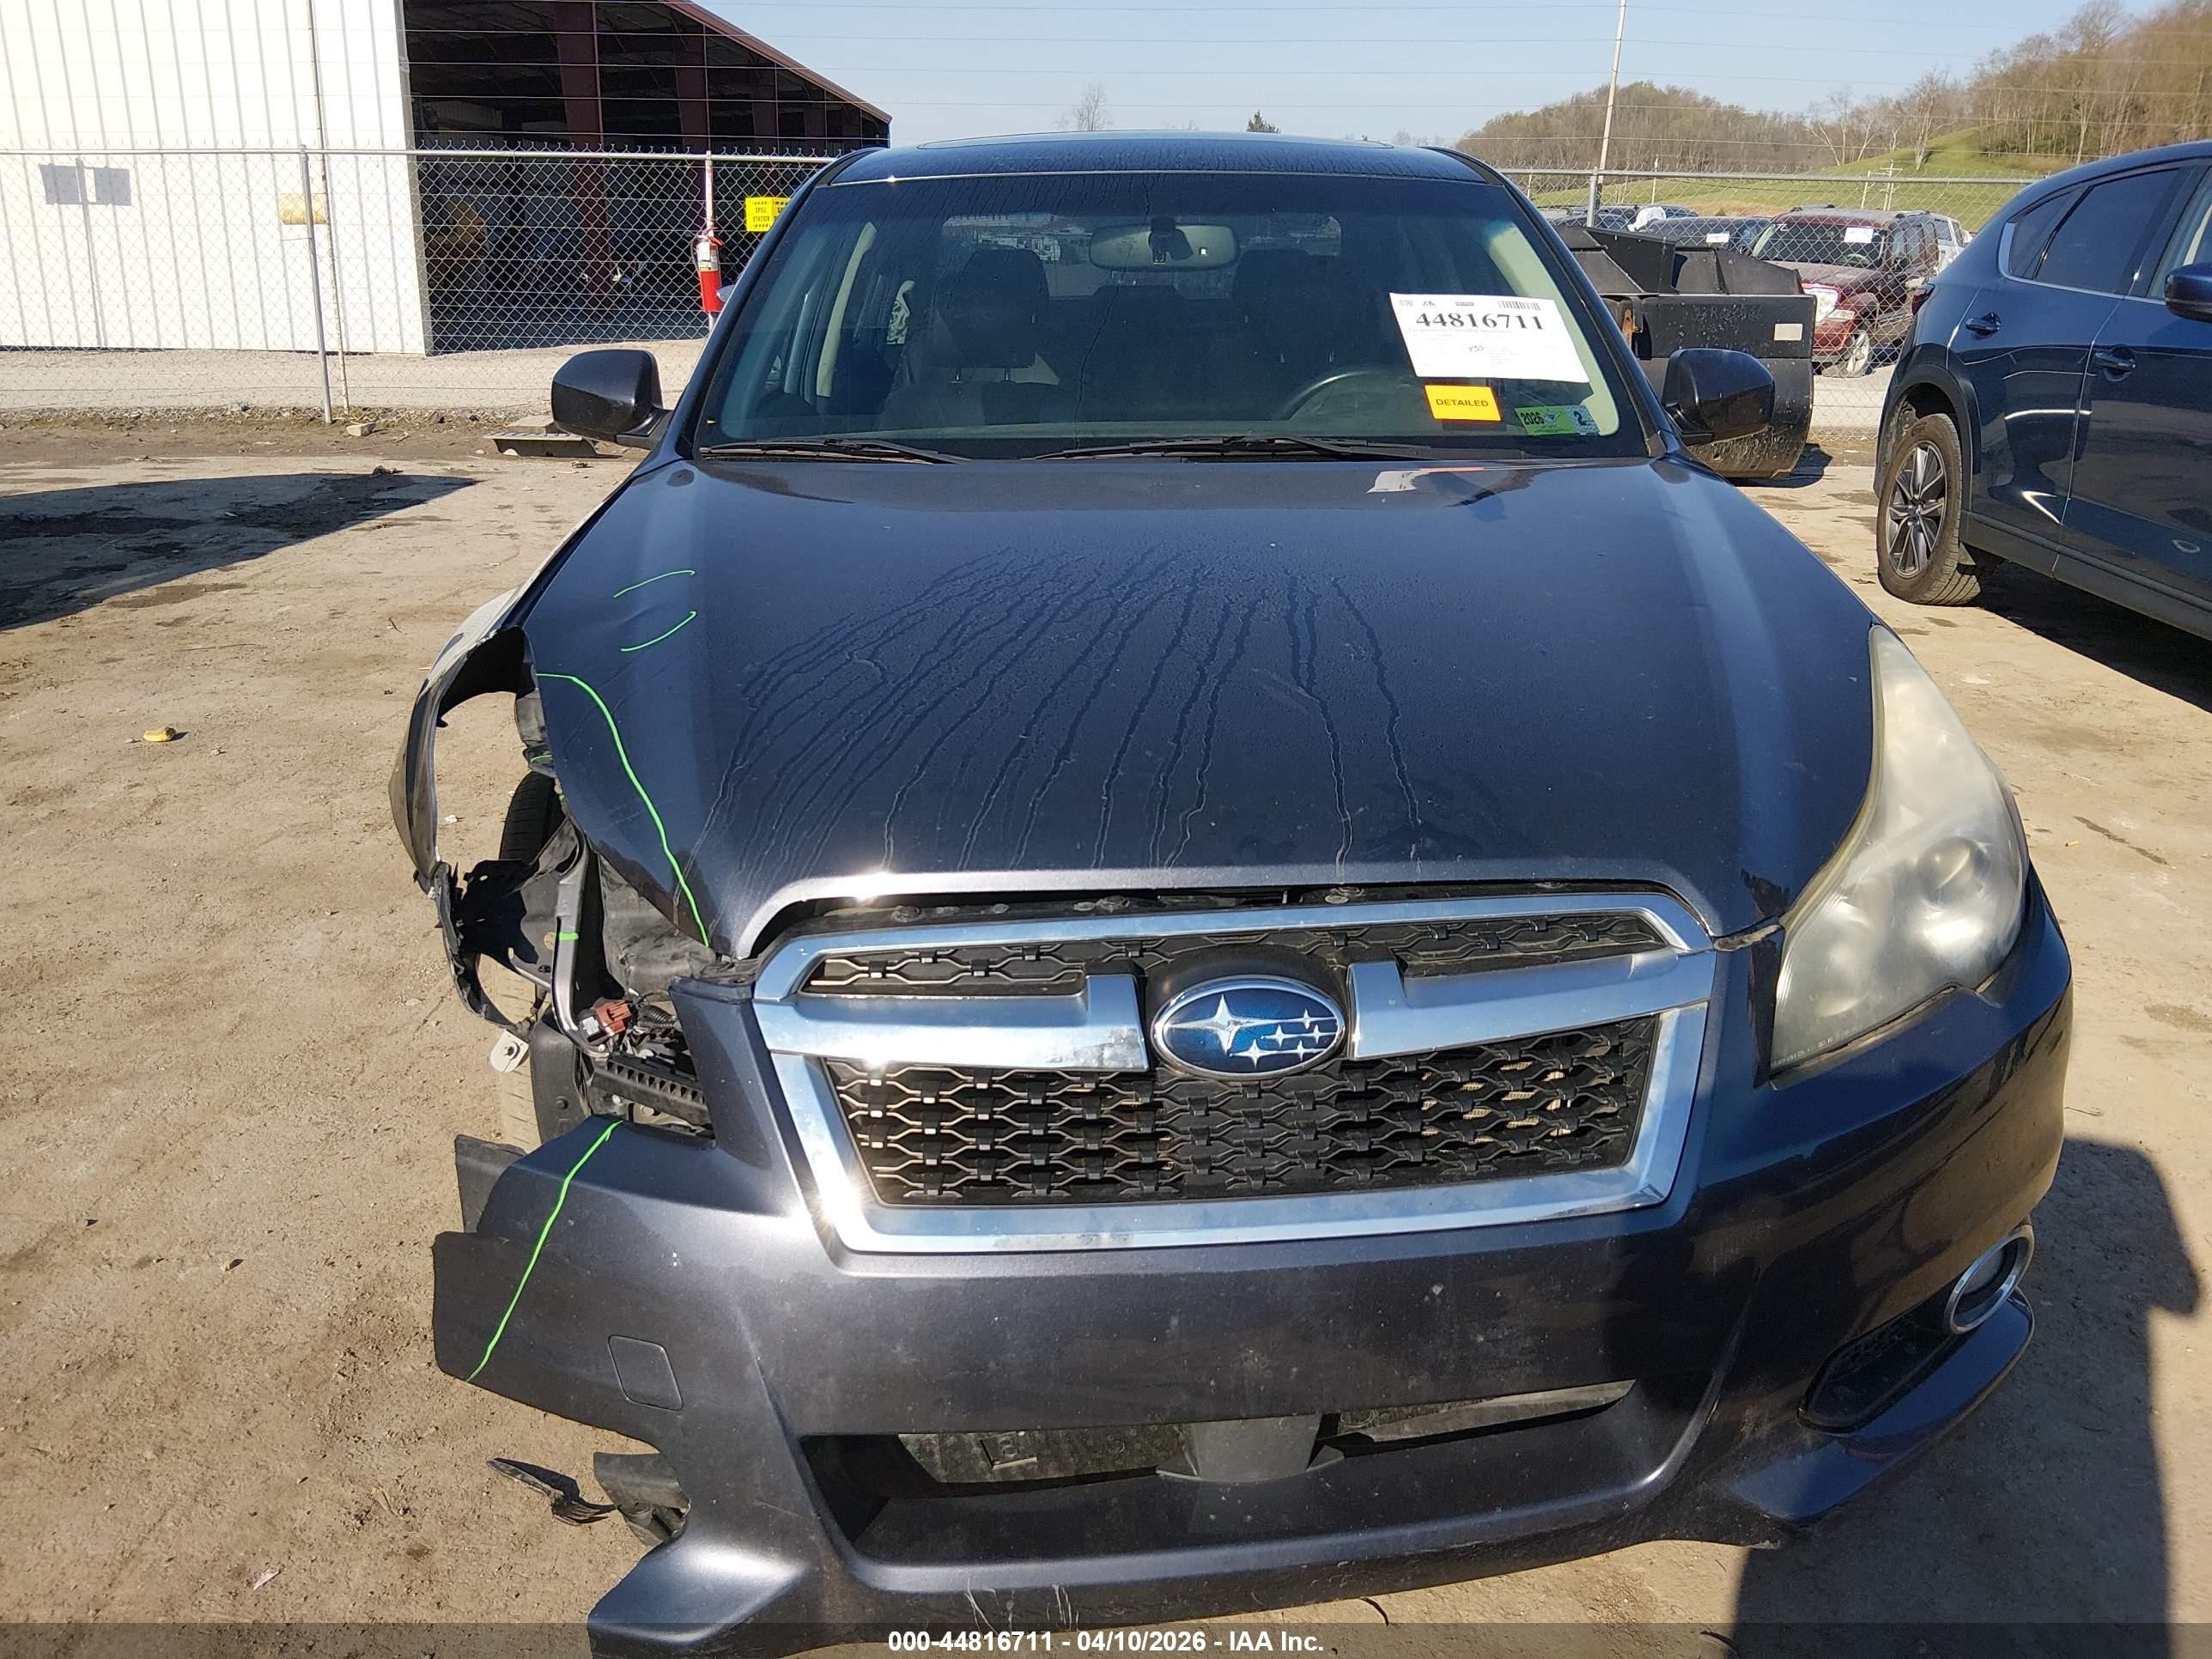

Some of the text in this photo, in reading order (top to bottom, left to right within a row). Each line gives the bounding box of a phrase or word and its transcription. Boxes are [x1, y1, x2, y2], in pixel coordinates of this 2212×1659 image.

[1415, 312, 1545, 331] 44816711
[1435, 398, 1489, 407] DETAILED
[1520, 410, 1589, 426] 2026 2
